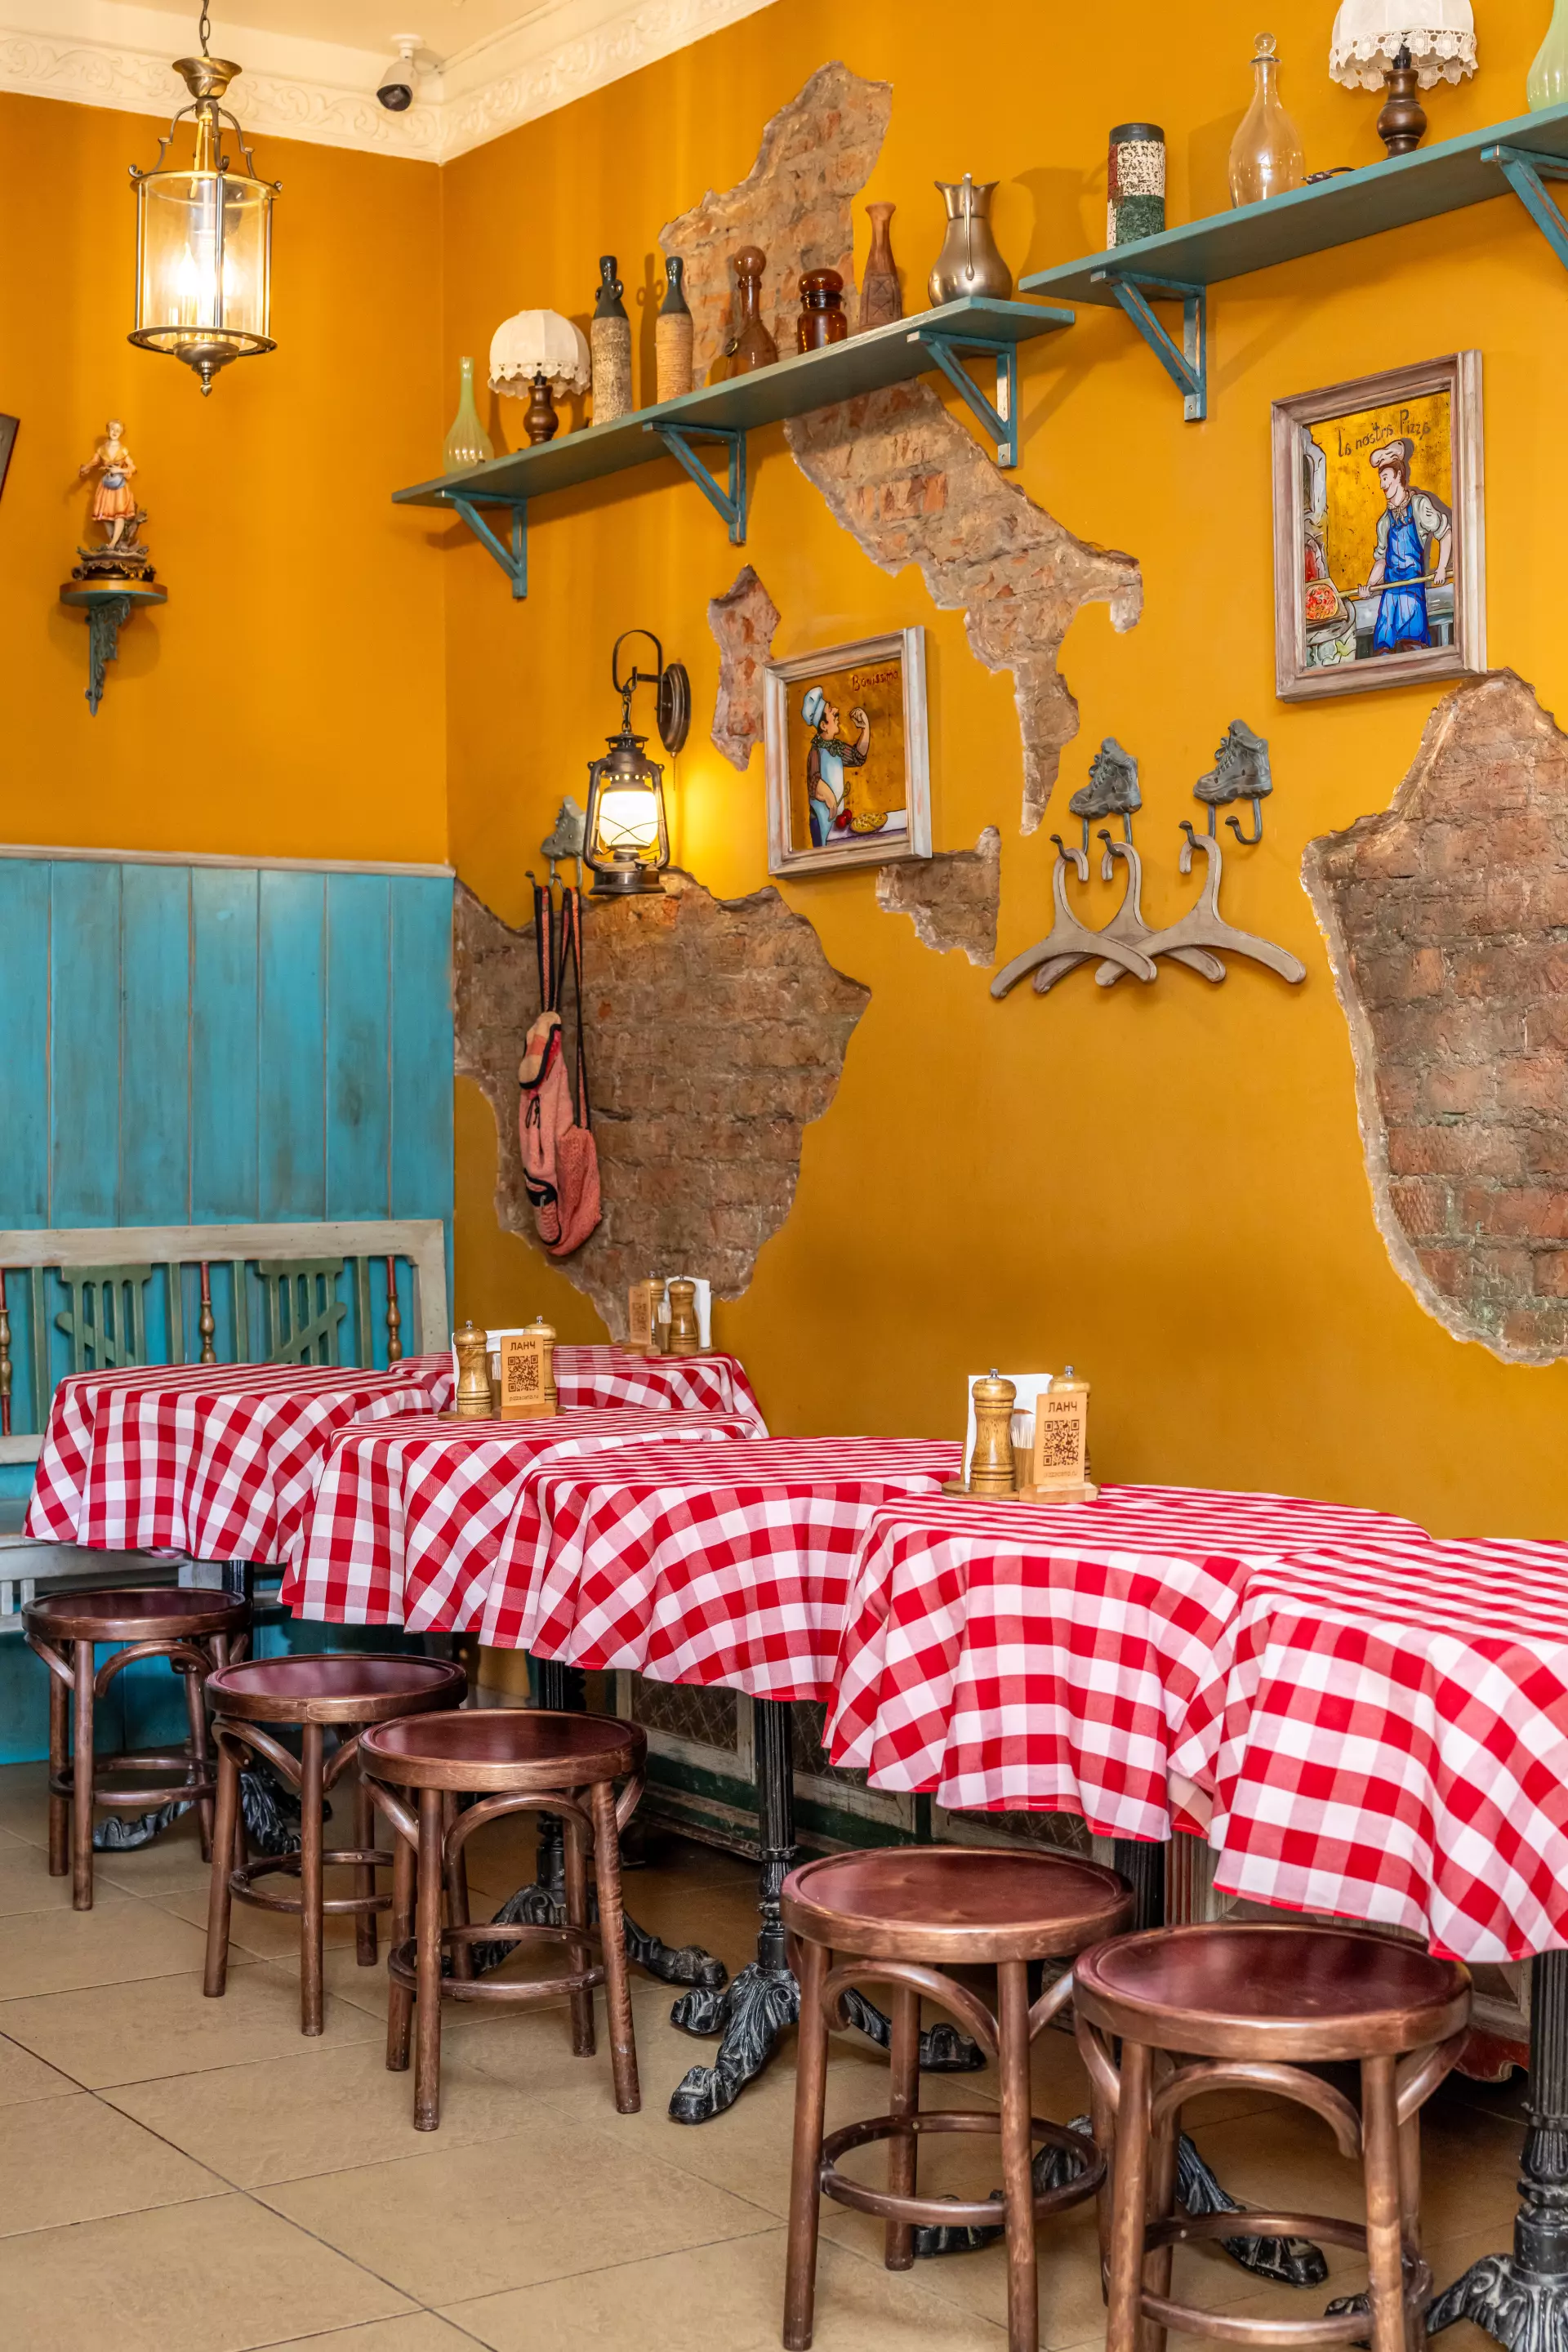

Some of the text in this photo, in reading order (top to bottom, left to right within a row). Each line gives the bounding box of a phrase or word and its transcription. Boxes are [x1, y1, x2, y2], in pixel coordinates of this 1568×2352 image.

[1400, 409, 1431, 441] Pizza
[510, 1340, 536, 1352] ЛАНЧ
[1049, 1401, 1078, 1413] ЛАНЧ
